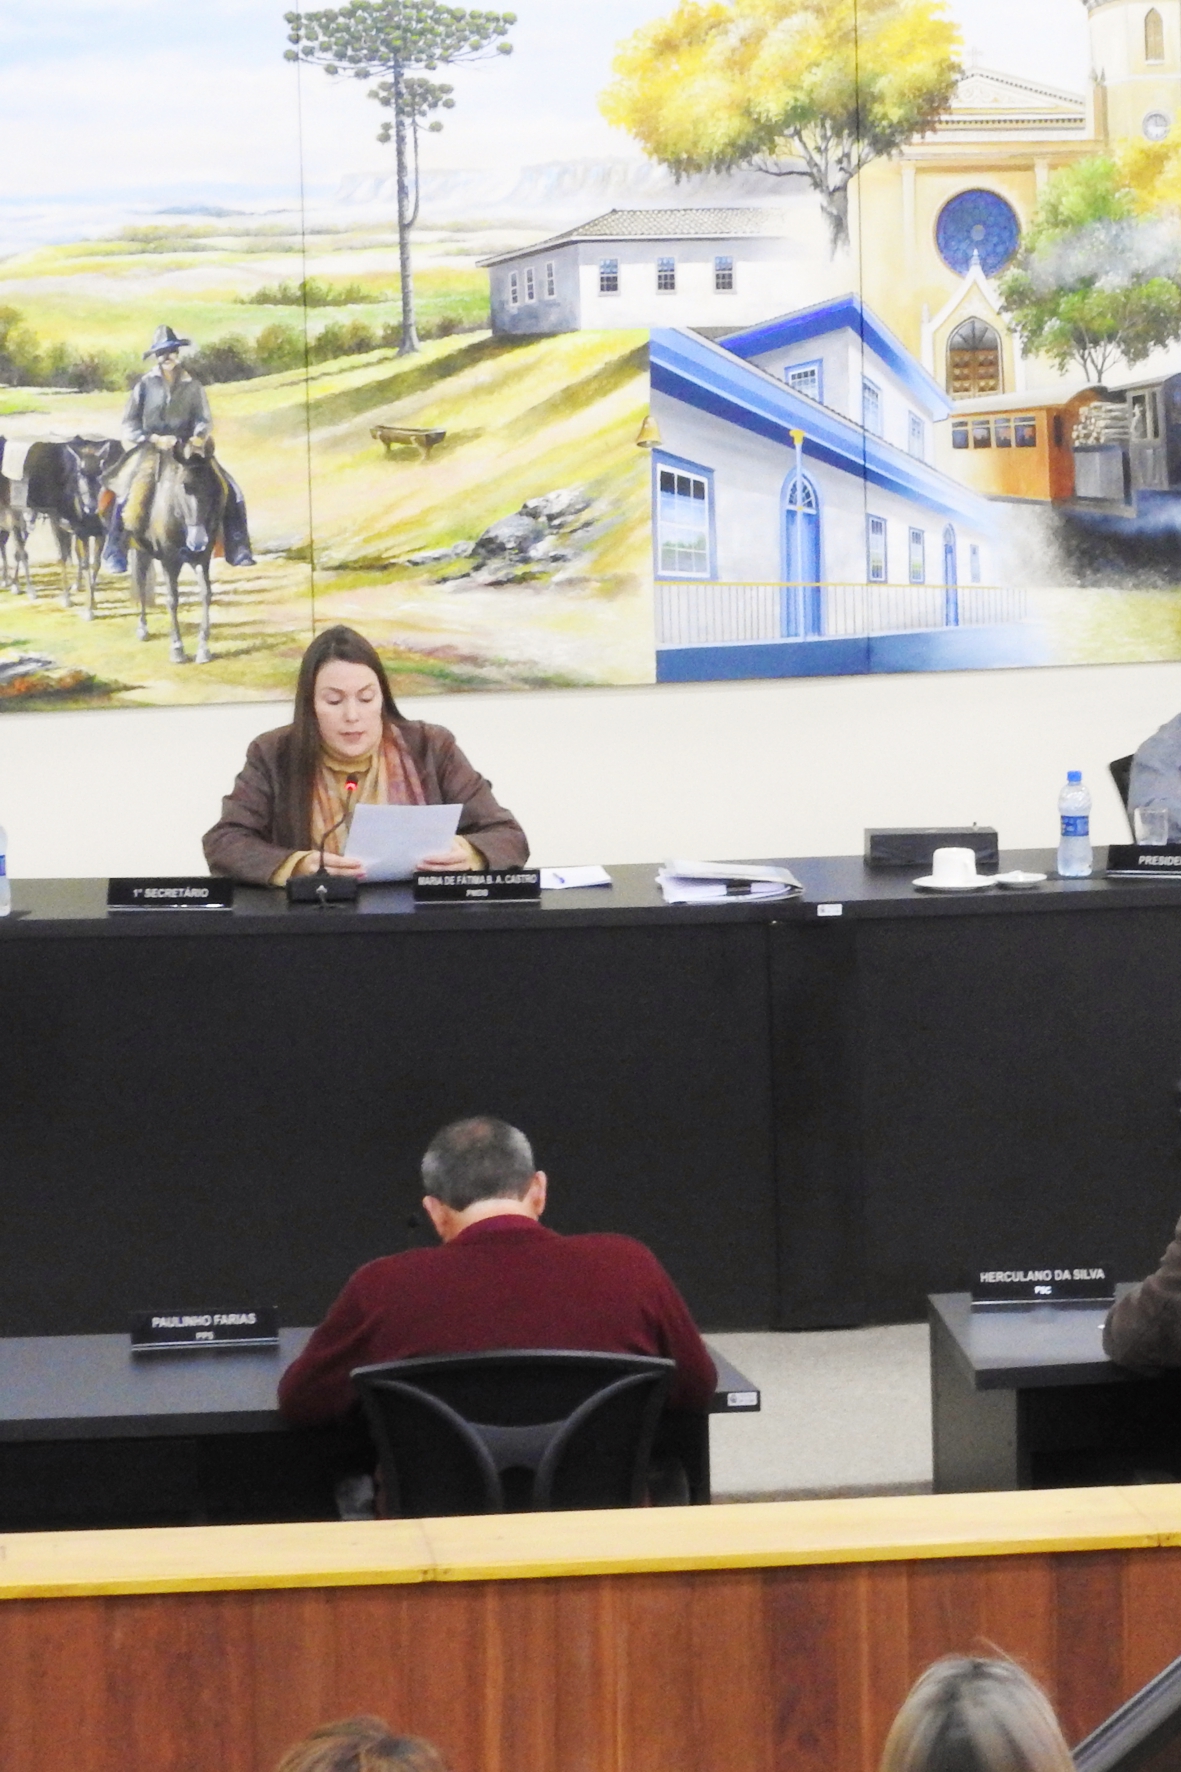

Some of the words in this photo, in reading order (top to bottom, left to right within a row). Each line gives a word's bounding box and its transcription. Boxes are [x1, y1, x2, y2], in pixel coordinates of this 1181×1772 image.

[417, 876, 444, 886] MARIA
[444, 875, 455, 885] DE
[456, 873, 485, 885] FÁTIMA
[504, 874, 537, 884] CASTRO
[144, 887, 209, 898] SECRETÁRIO
[980, 1270, 1052, 1283] HERCULANO
[1054, 1269, 1071, 1281] DA
[1072, 1268, 1105, 1280] SILVA
[151, 1315, 212, 1328] PAULINHO
[213, 1312, 257, 1326] FARIAS
